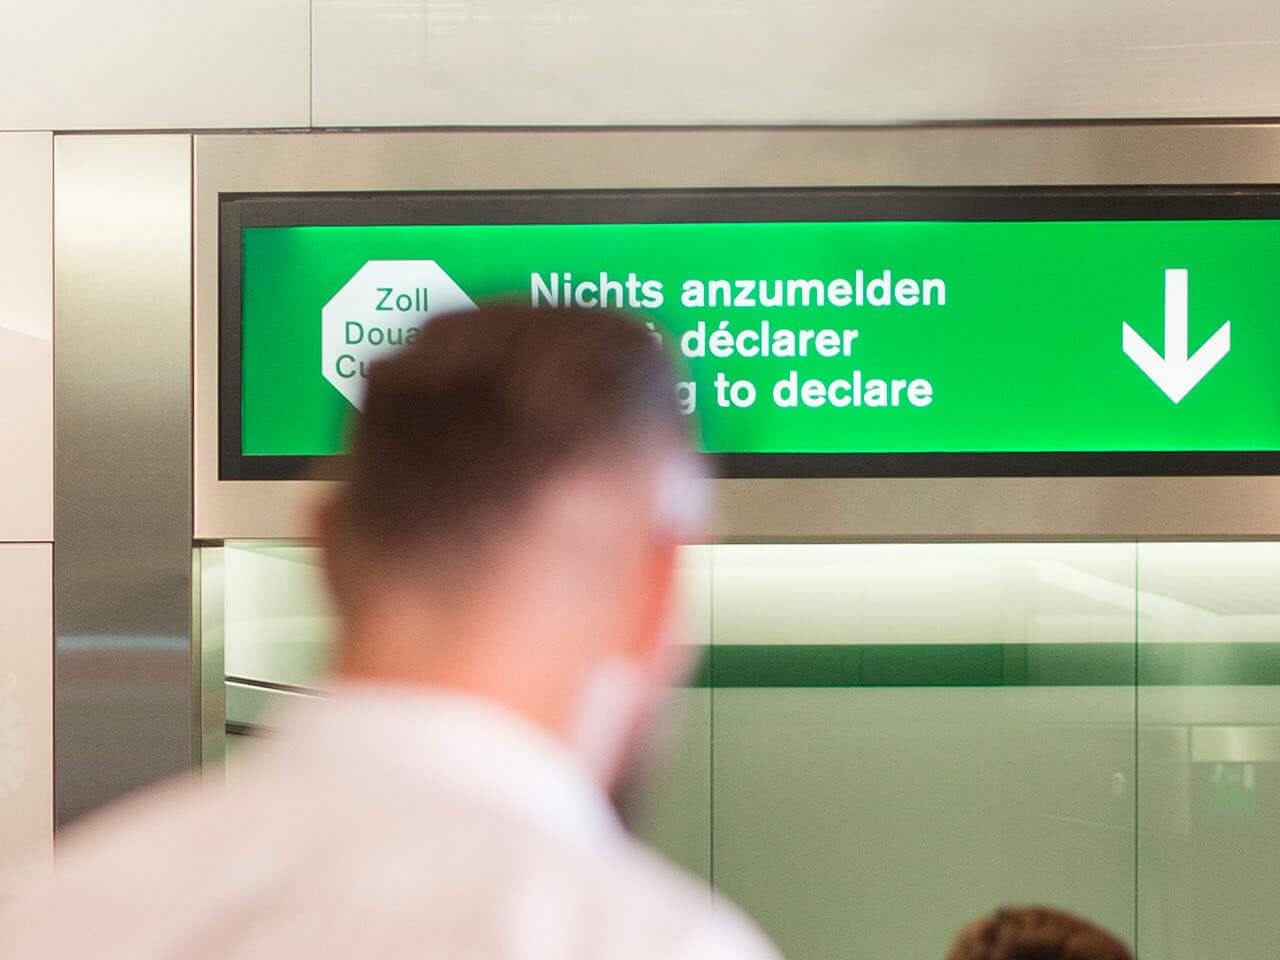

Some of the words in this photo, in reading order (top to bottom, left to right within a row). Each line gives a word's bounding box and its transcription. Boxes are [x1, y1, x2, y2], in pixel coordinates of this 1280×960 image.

[375, 287, 429, 312] Zoll
[530, 271, 664, 309] Nichts
[680, 269, 946, 308] anzumelden
[344, 320, 422, 346] Doua
[679, 319, 859, 358] déclarer
[713, 372, 757, 408] to
[772, 369, 933, 408] declare
